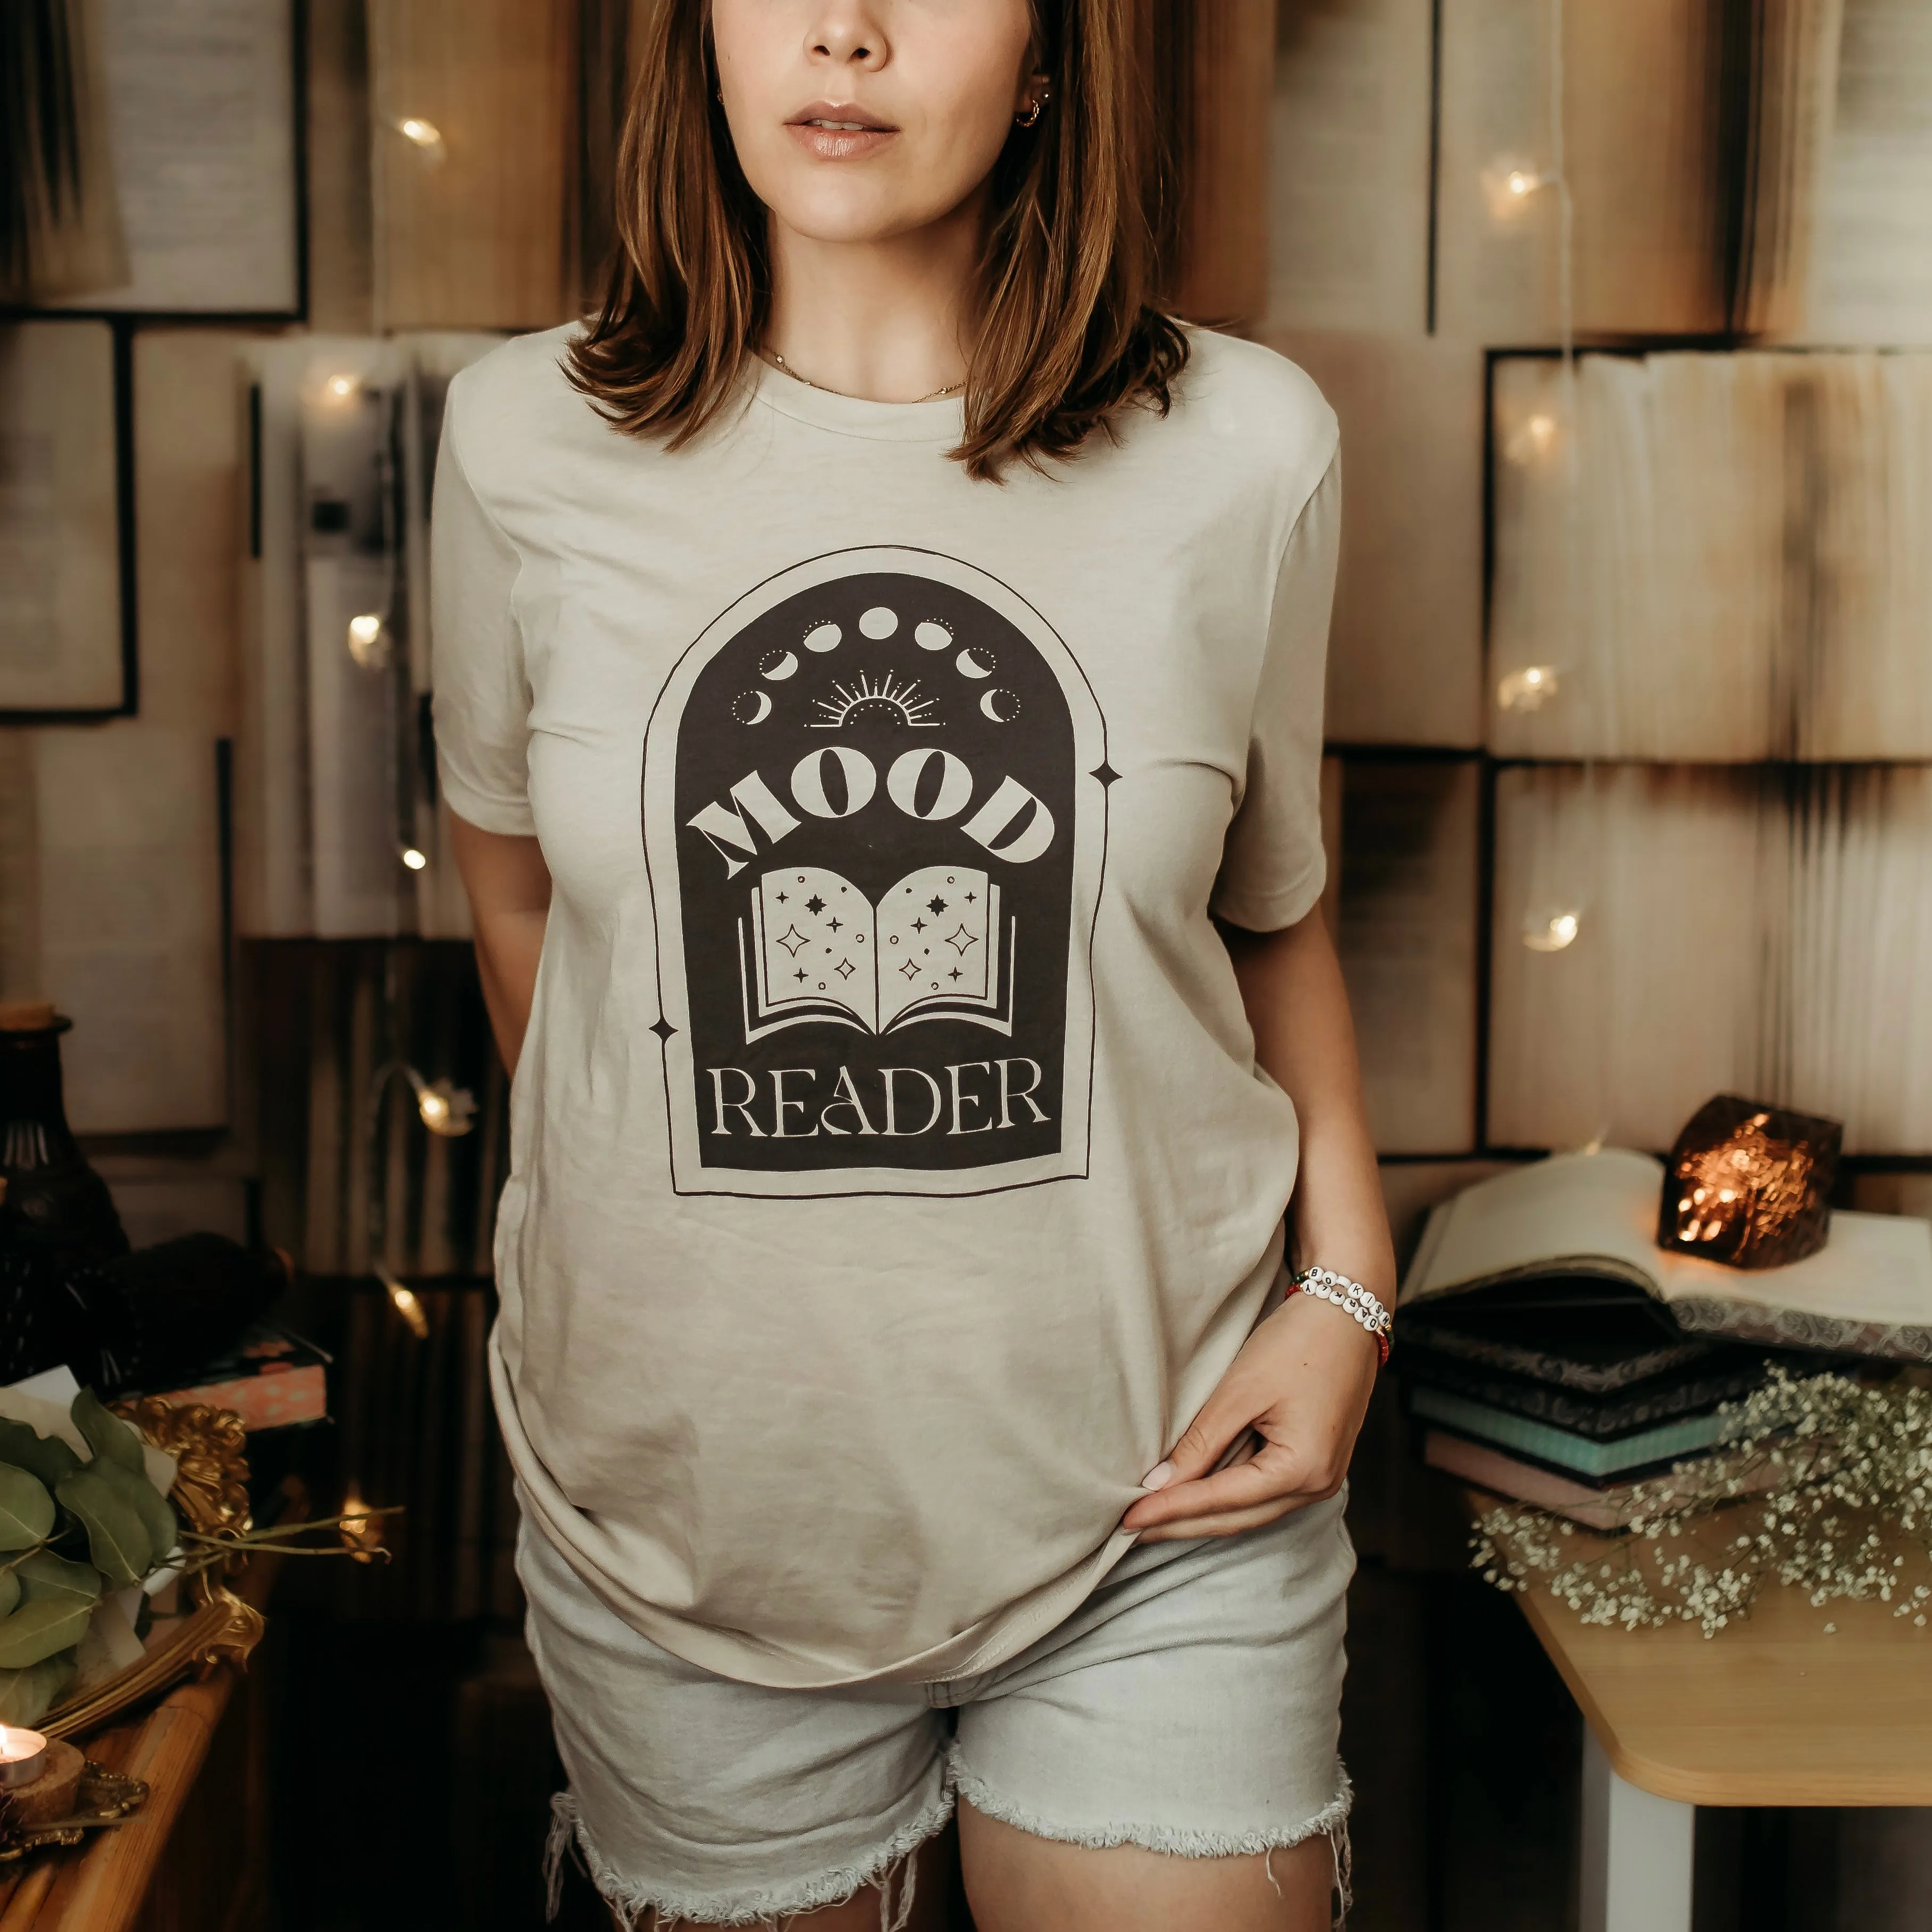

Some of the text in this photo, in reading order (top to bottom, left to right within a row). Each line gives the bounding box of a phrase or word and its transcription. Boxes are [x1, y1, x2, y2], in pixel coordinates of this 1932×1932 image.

[685, 747, 1055, 880] MOOD
[706, 1057, 1051, 1138] READER
[1311, 1268, 1390, 1325] BOKISH
